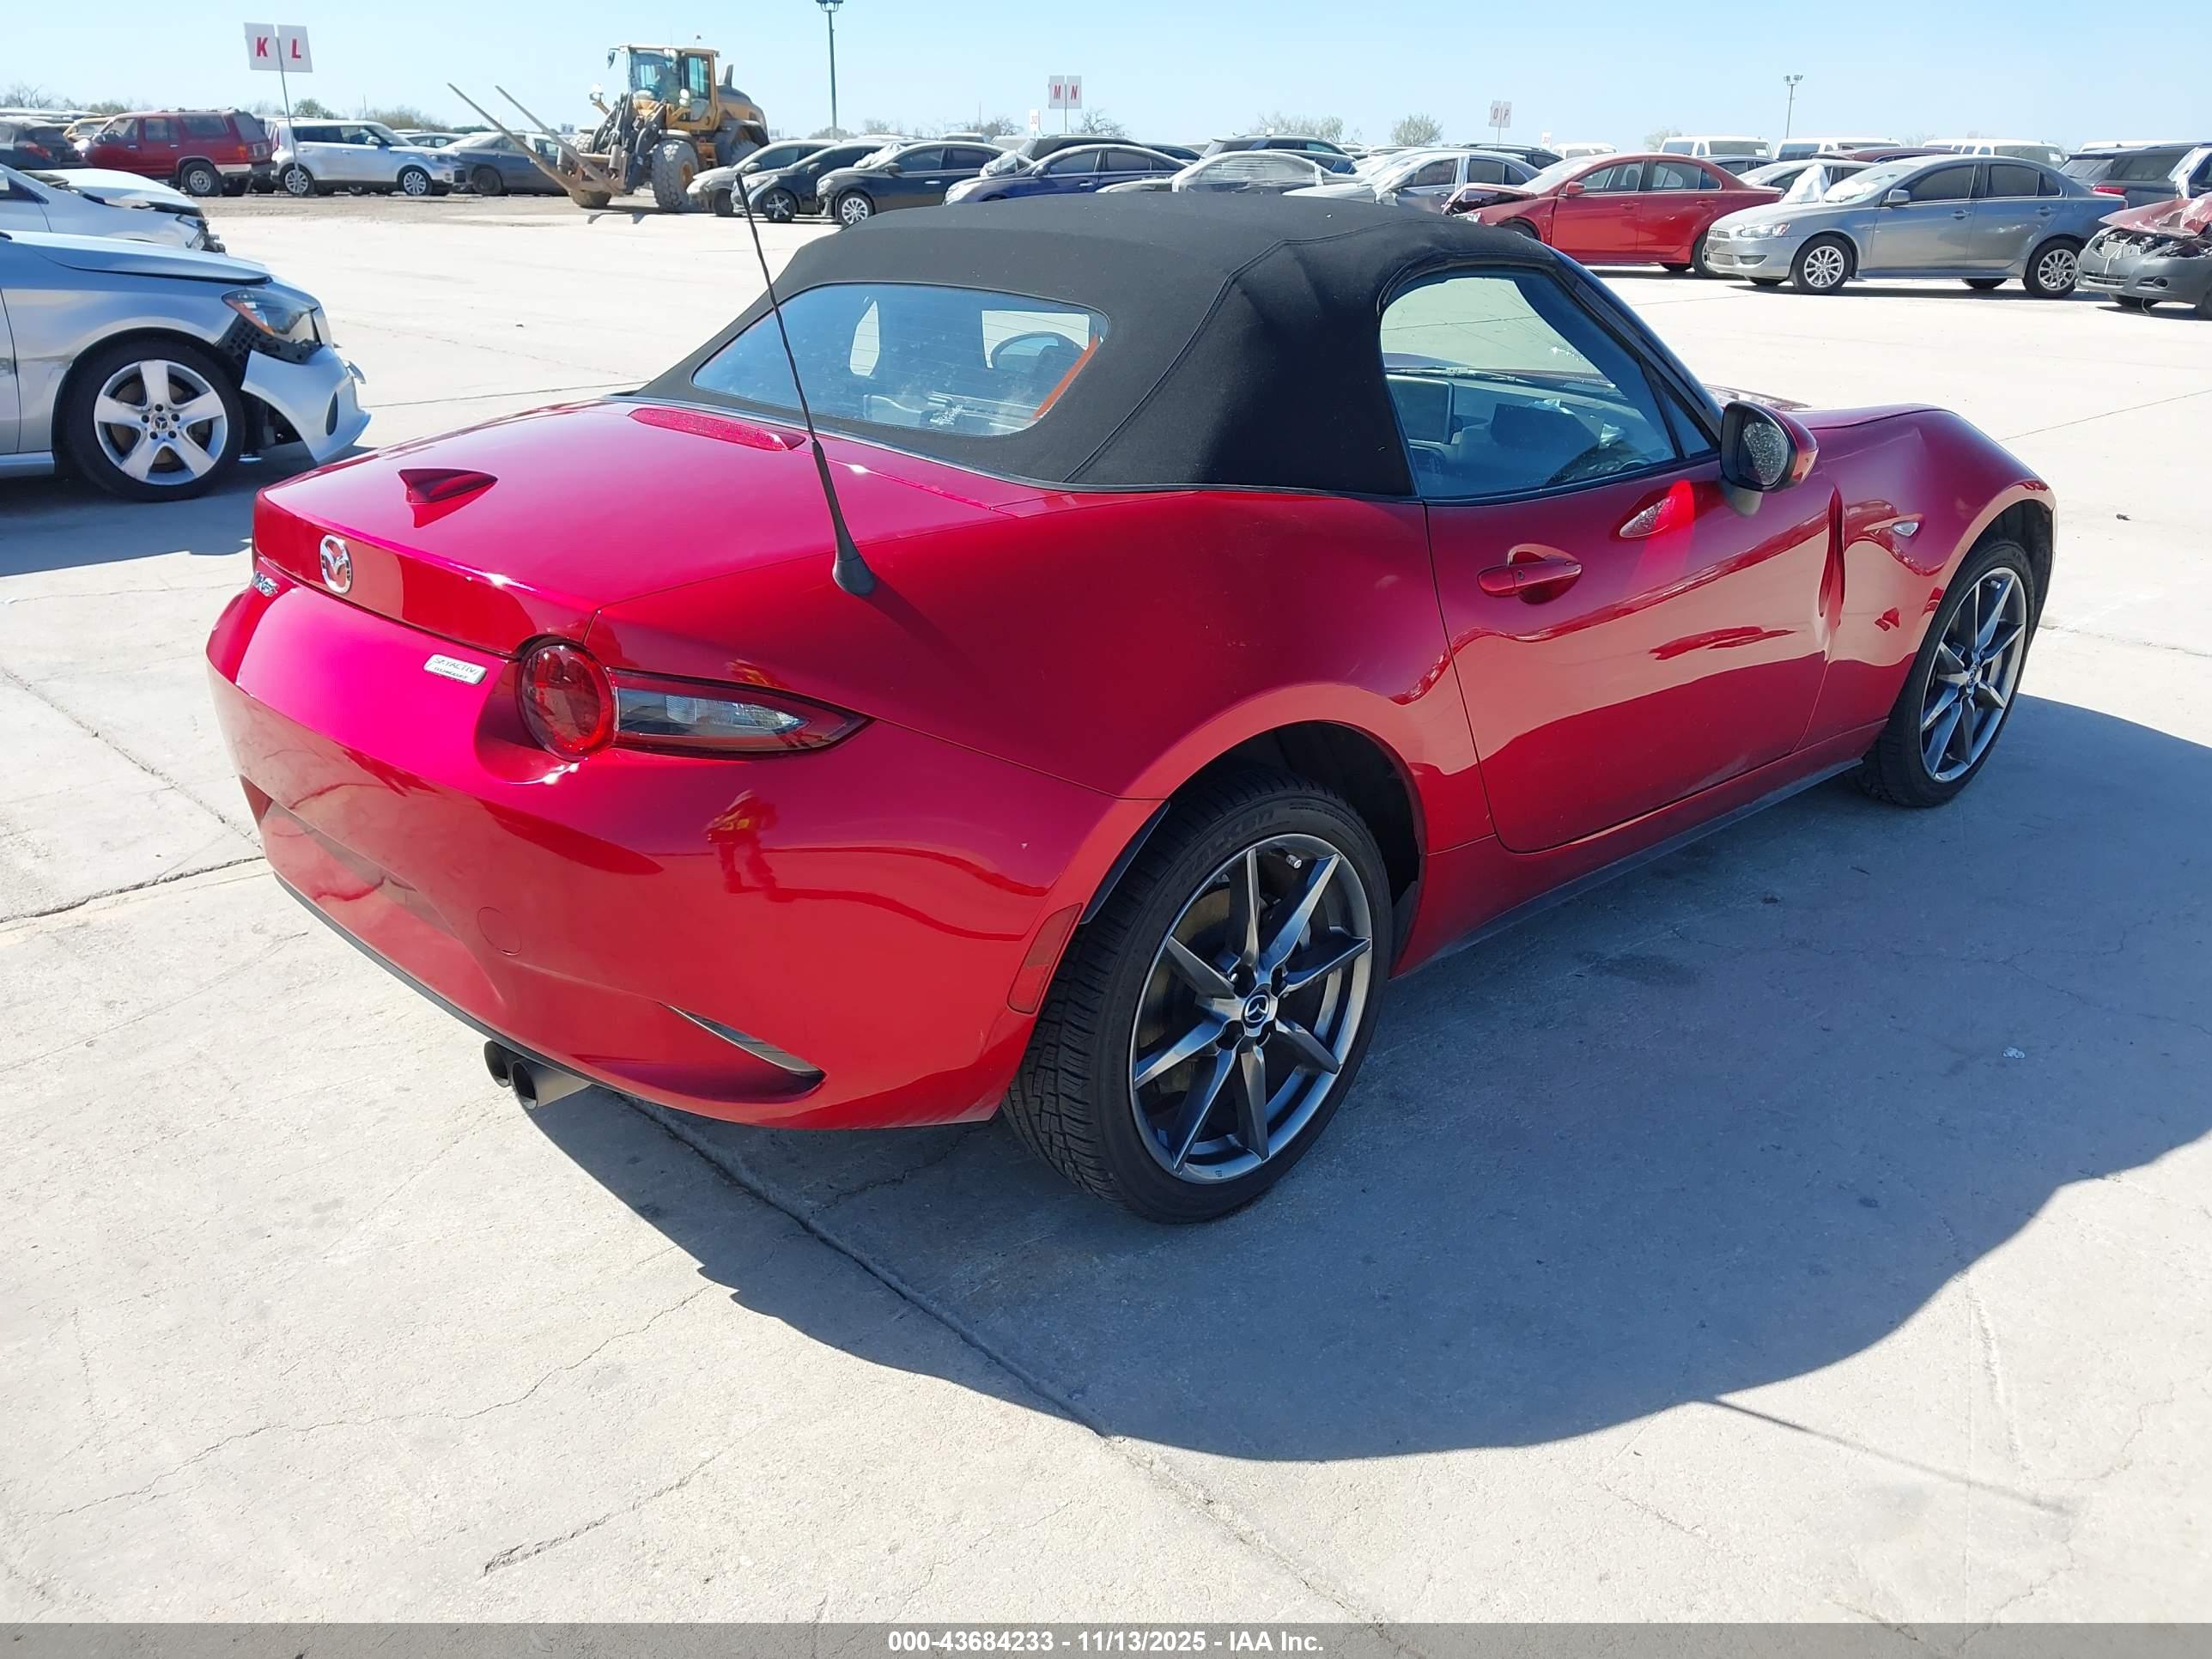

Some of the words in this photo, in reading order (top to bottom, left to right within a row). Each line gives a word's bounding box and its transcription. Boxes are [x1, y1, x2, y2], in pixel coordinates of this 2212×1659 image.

[256, 36, 268, 58] K
[291, 38, 302, 59] L
[1053, 84, 1061, 100] M
[1070, 84, 1079, 100] N
